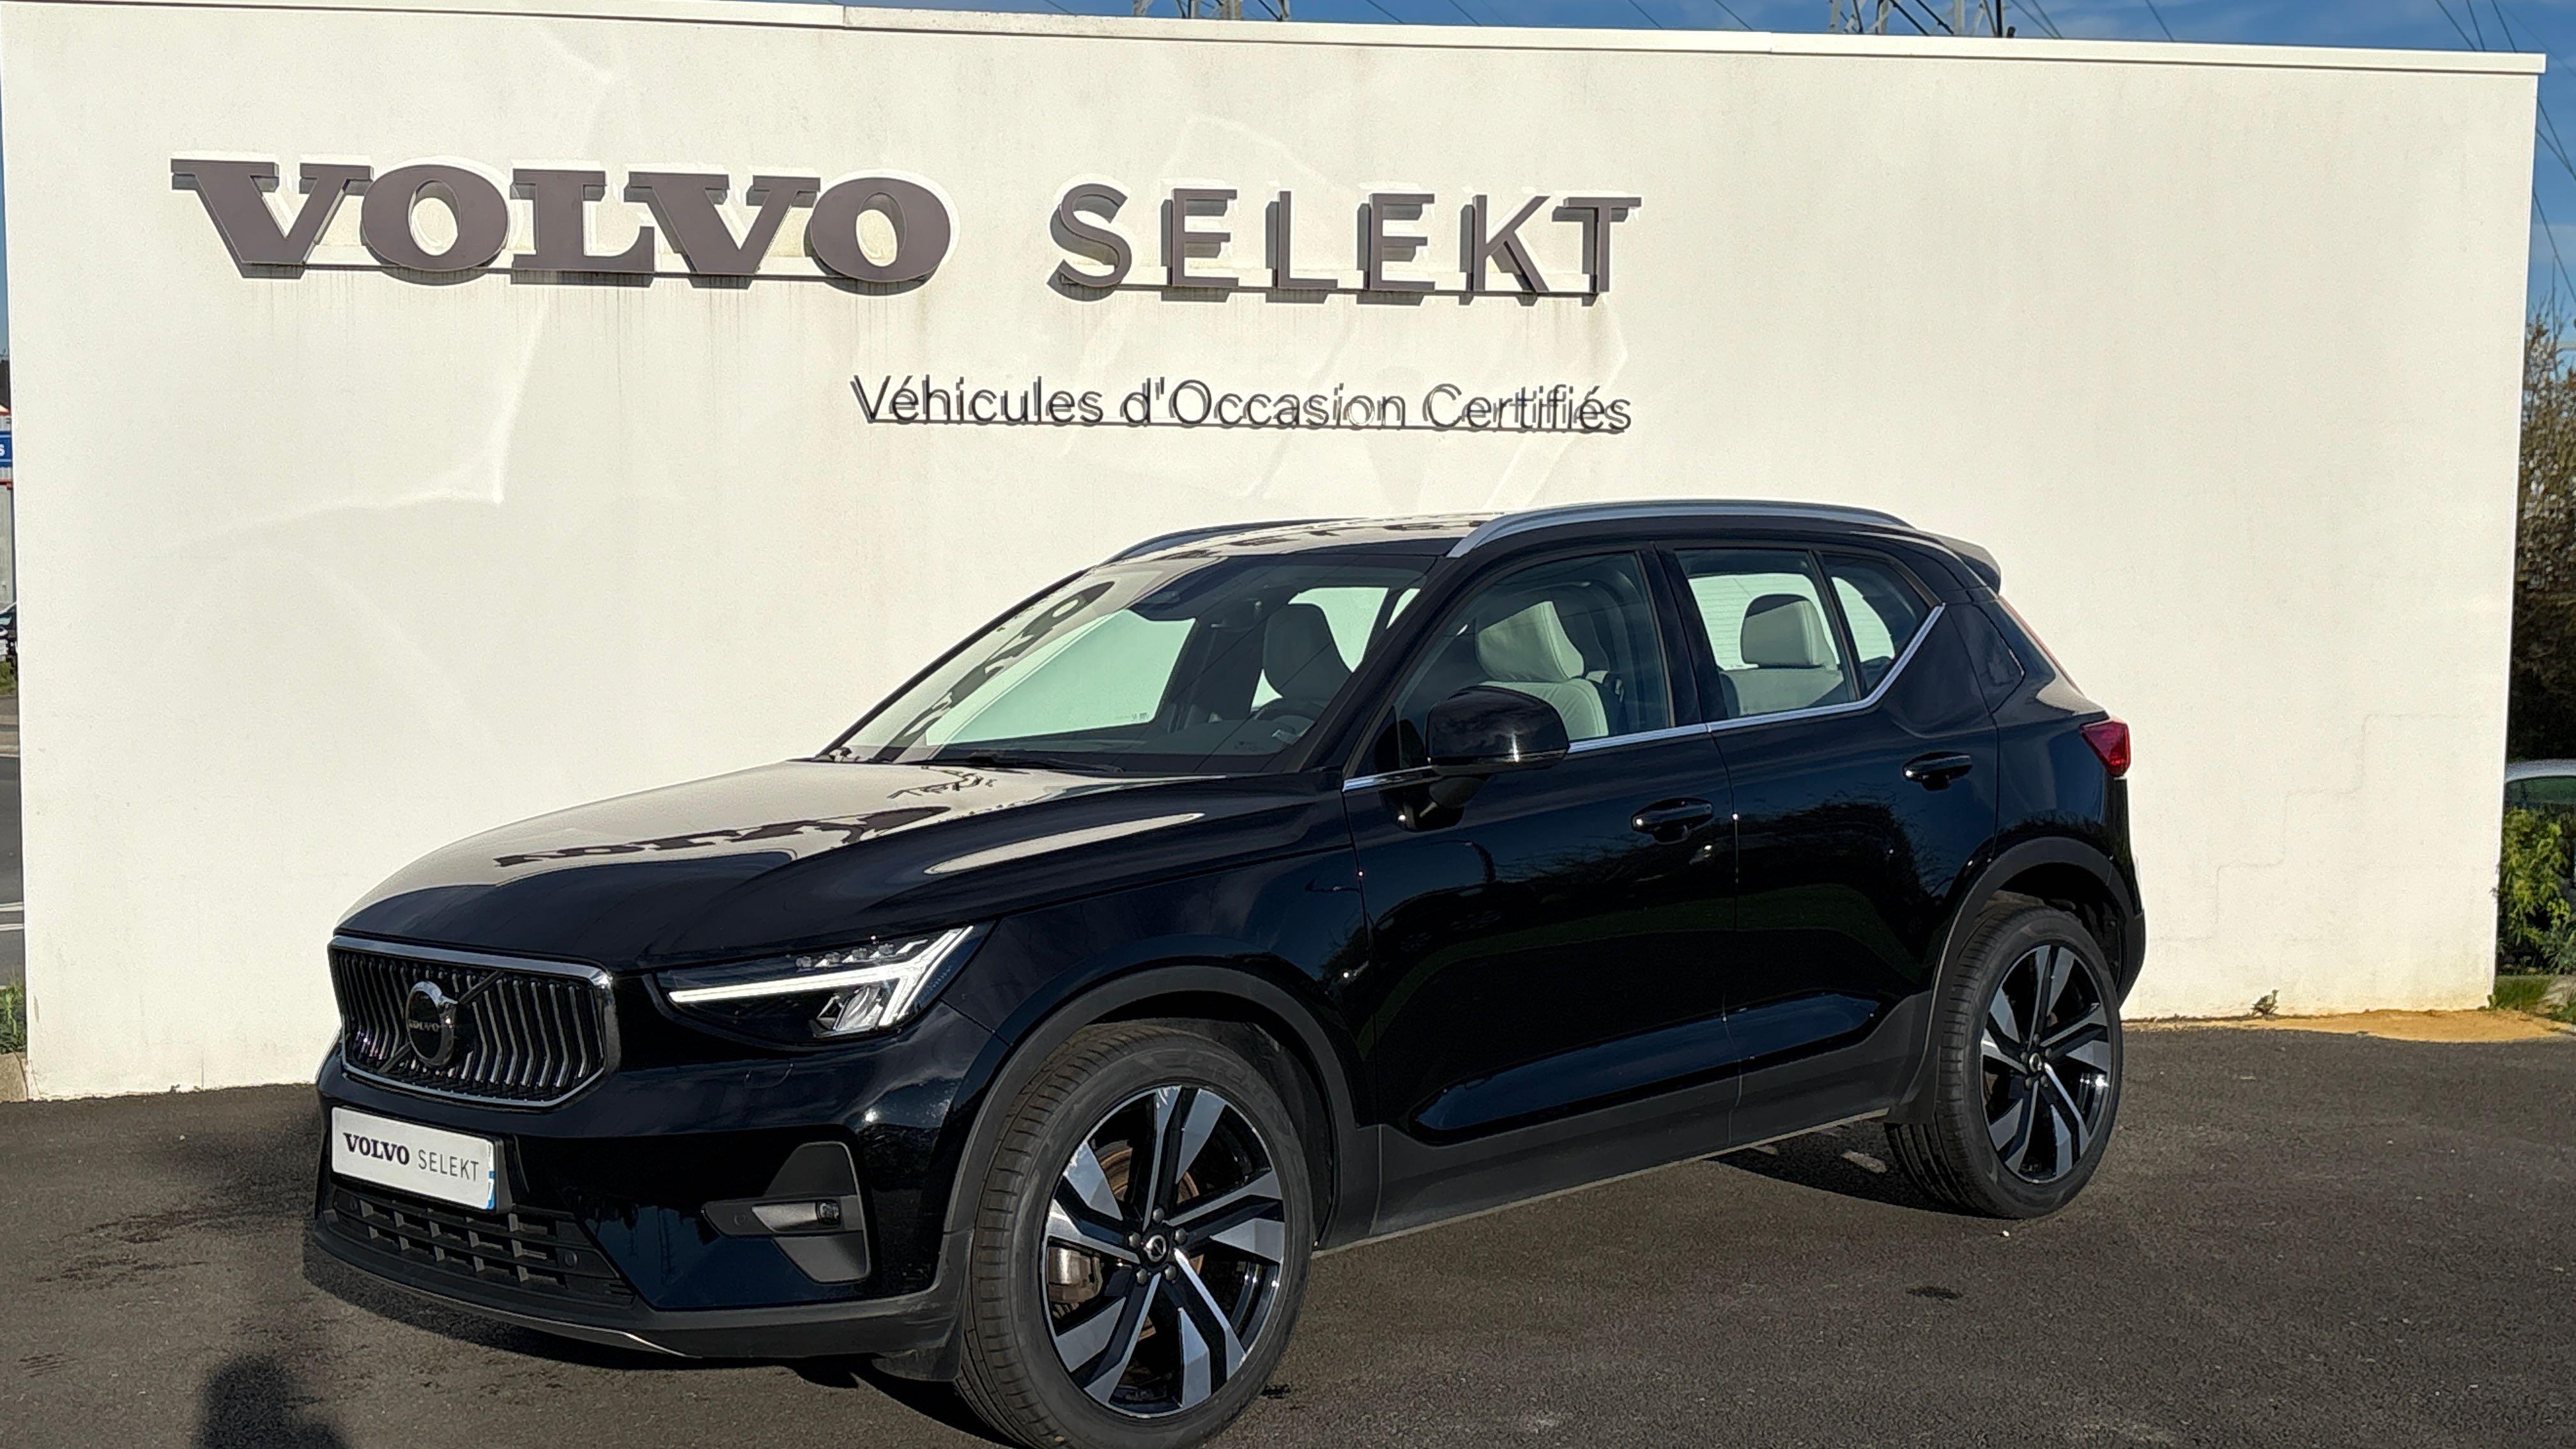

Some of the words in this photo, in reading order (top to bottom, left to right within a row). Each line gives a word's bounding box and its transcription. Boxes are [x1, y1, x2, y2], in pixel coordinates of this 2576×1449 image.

[171, 158, 952, 293] VOLVO
[1051, 183, 1642, 300] SELEKT
[850, 374, 1104, 424] Véhicules
[1120, 376, 1406, 428] d'Occasion
[1423, 383, 1632, 431] Certifiés
[342, 1133, 410, 1165] VOLVO
[418, 1149, 479, 1181] SELEKT
